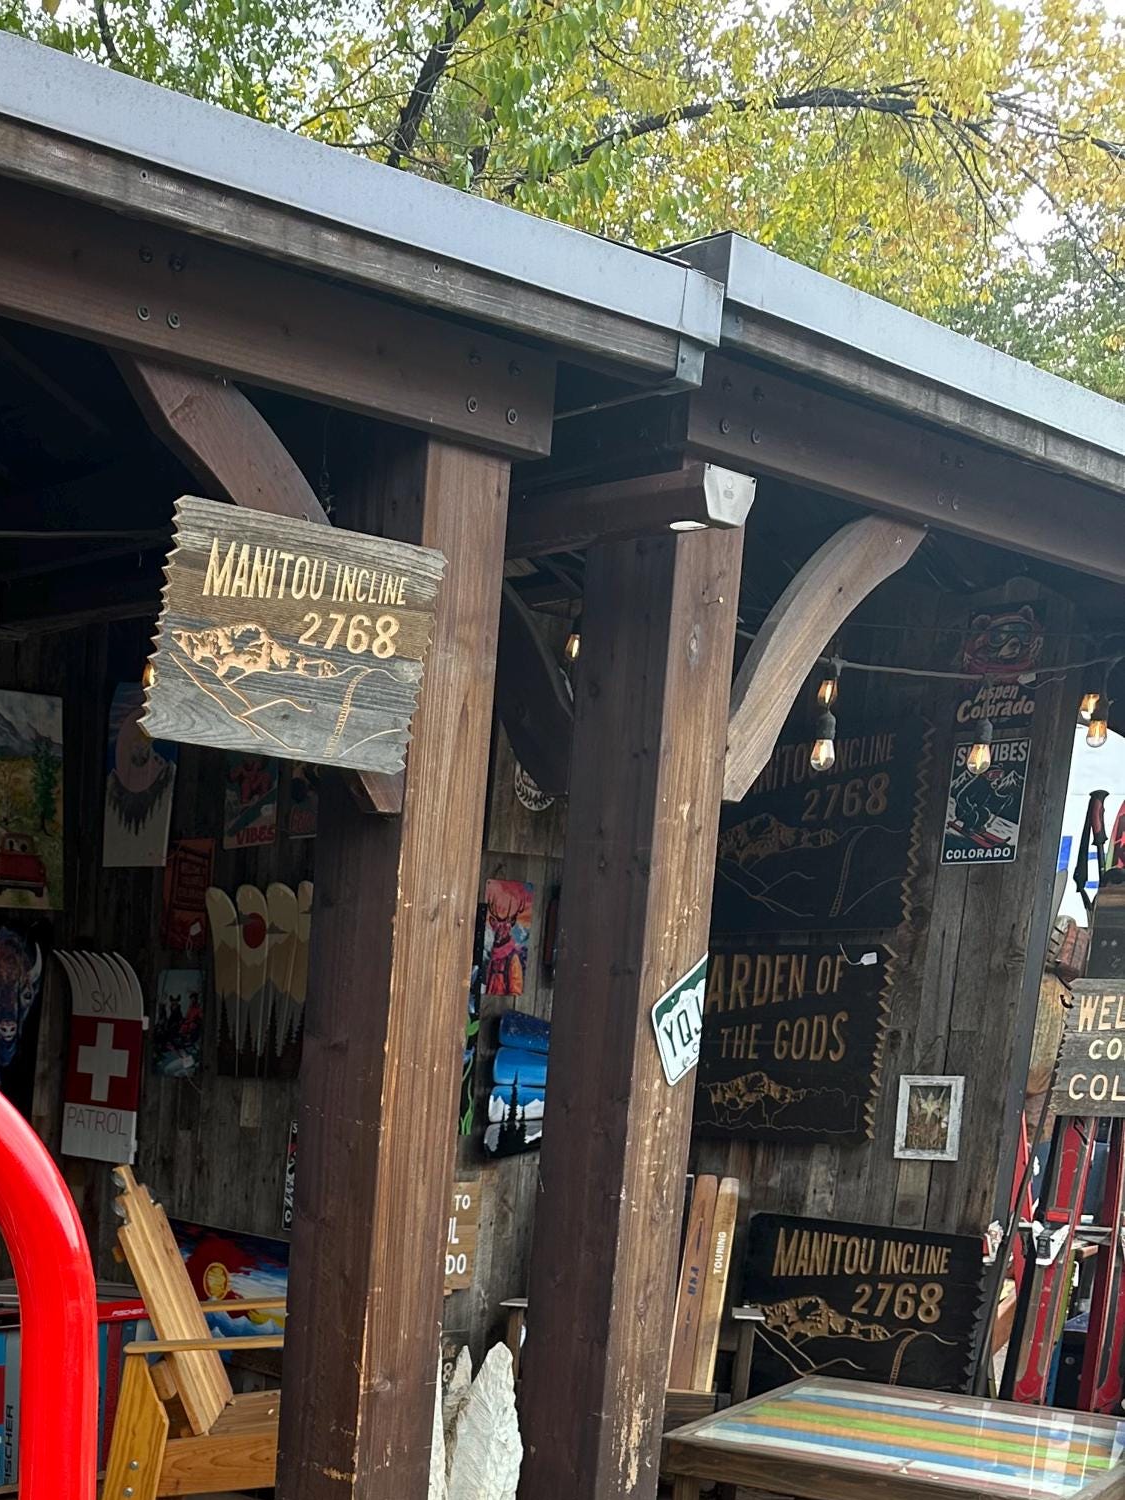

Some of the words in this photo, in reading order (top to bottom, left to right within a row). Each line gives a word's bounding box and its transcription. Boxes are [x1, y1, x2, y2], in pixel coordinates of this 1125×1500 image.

[202, 537, 328, 601] MANITOU
[332, 563, 409, 606] INCLINE
[298, 611, 400, 659] 2768
[957, 698, 1036, 724] Colorado
[975, 684, 1020, 713] Aspen
[801, 772, 890, 822] 2768
[946, 847, 1011, 860] COLORADO
[816, 954, 847, 994] OF
[91, 990, 117, 1013] SKI
[720, 1023, 763, 1060] THE
[774, 1011, 850, 1063] GODS
[66, 1106, 127, 1136] PATROL
[454, 1194, 471, 1211] TO
[445, 1253, 467, 1275] DO
[713, 1231, 727, 1275] TOURING
[772, 1226, 876, 1277] MANITOU
[879, 1239, 953, 1275] INCLINE
[851, 1281, 944, 1324] 2768
